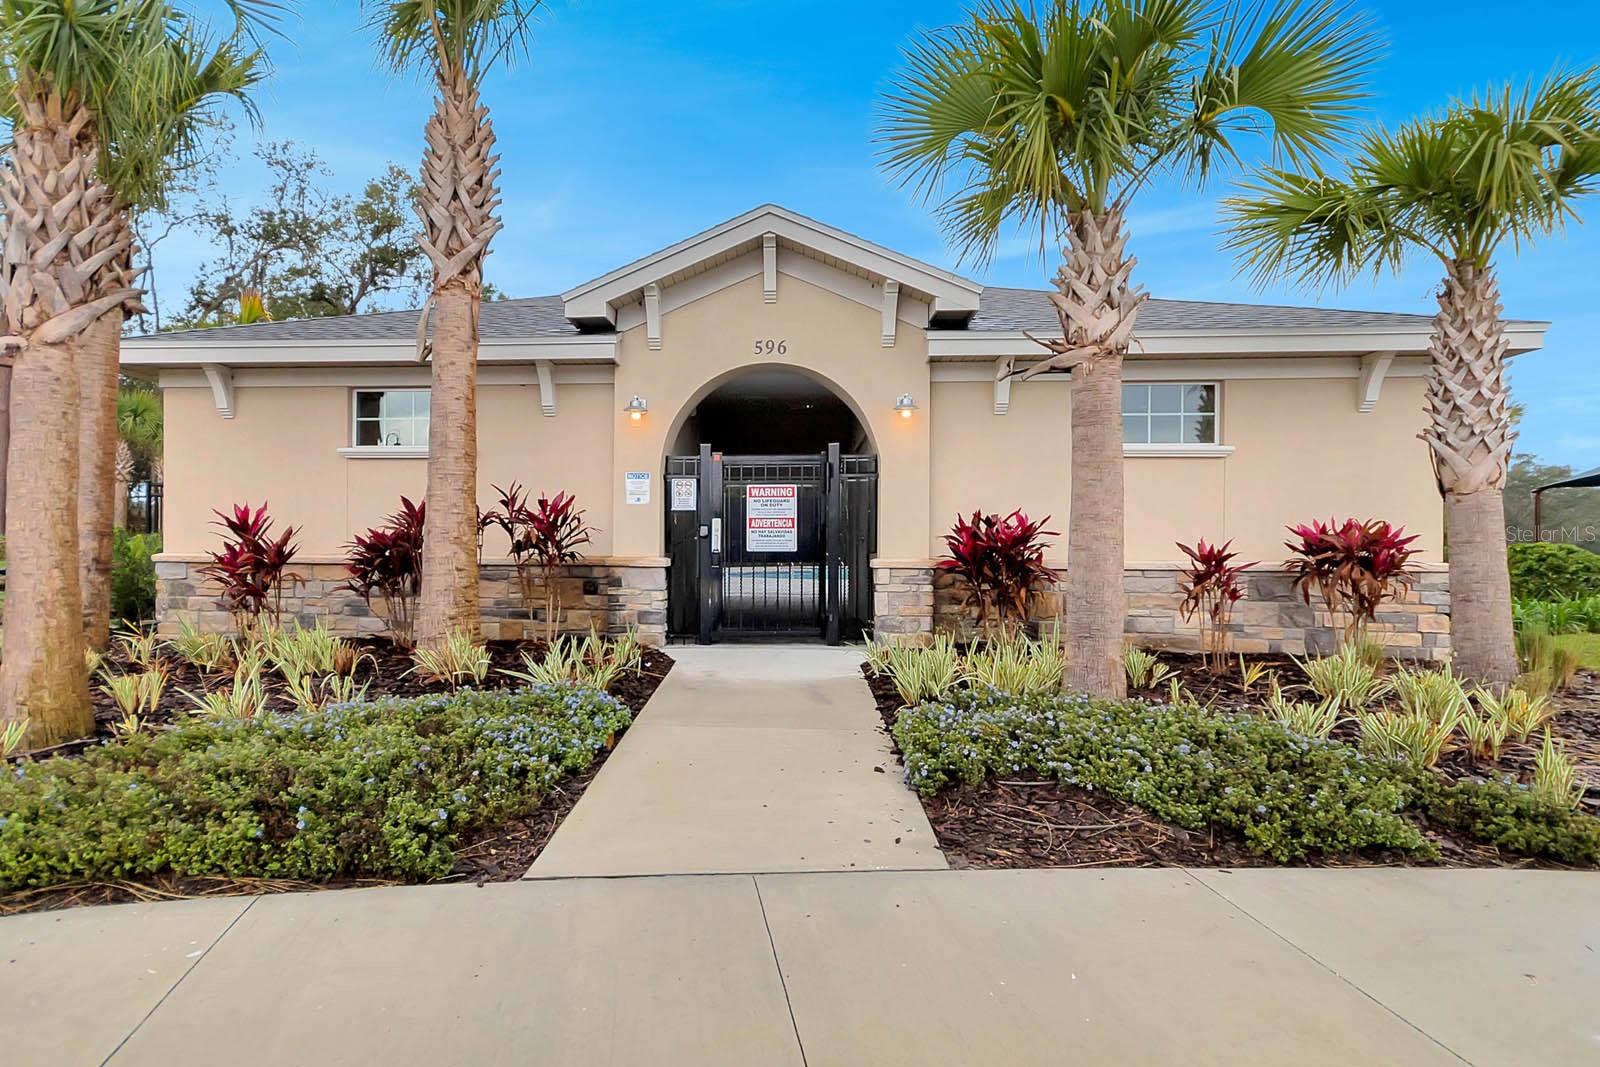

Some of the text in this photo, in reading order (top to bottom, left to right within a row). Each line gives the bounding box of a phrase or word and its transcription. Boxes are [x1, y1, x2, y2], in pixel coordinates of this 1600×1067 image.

[754, 337, 787, 355] 596
[751, 487, 793, 497] WARNING
[751, 518, 793, 528] ADVERTENCIA
